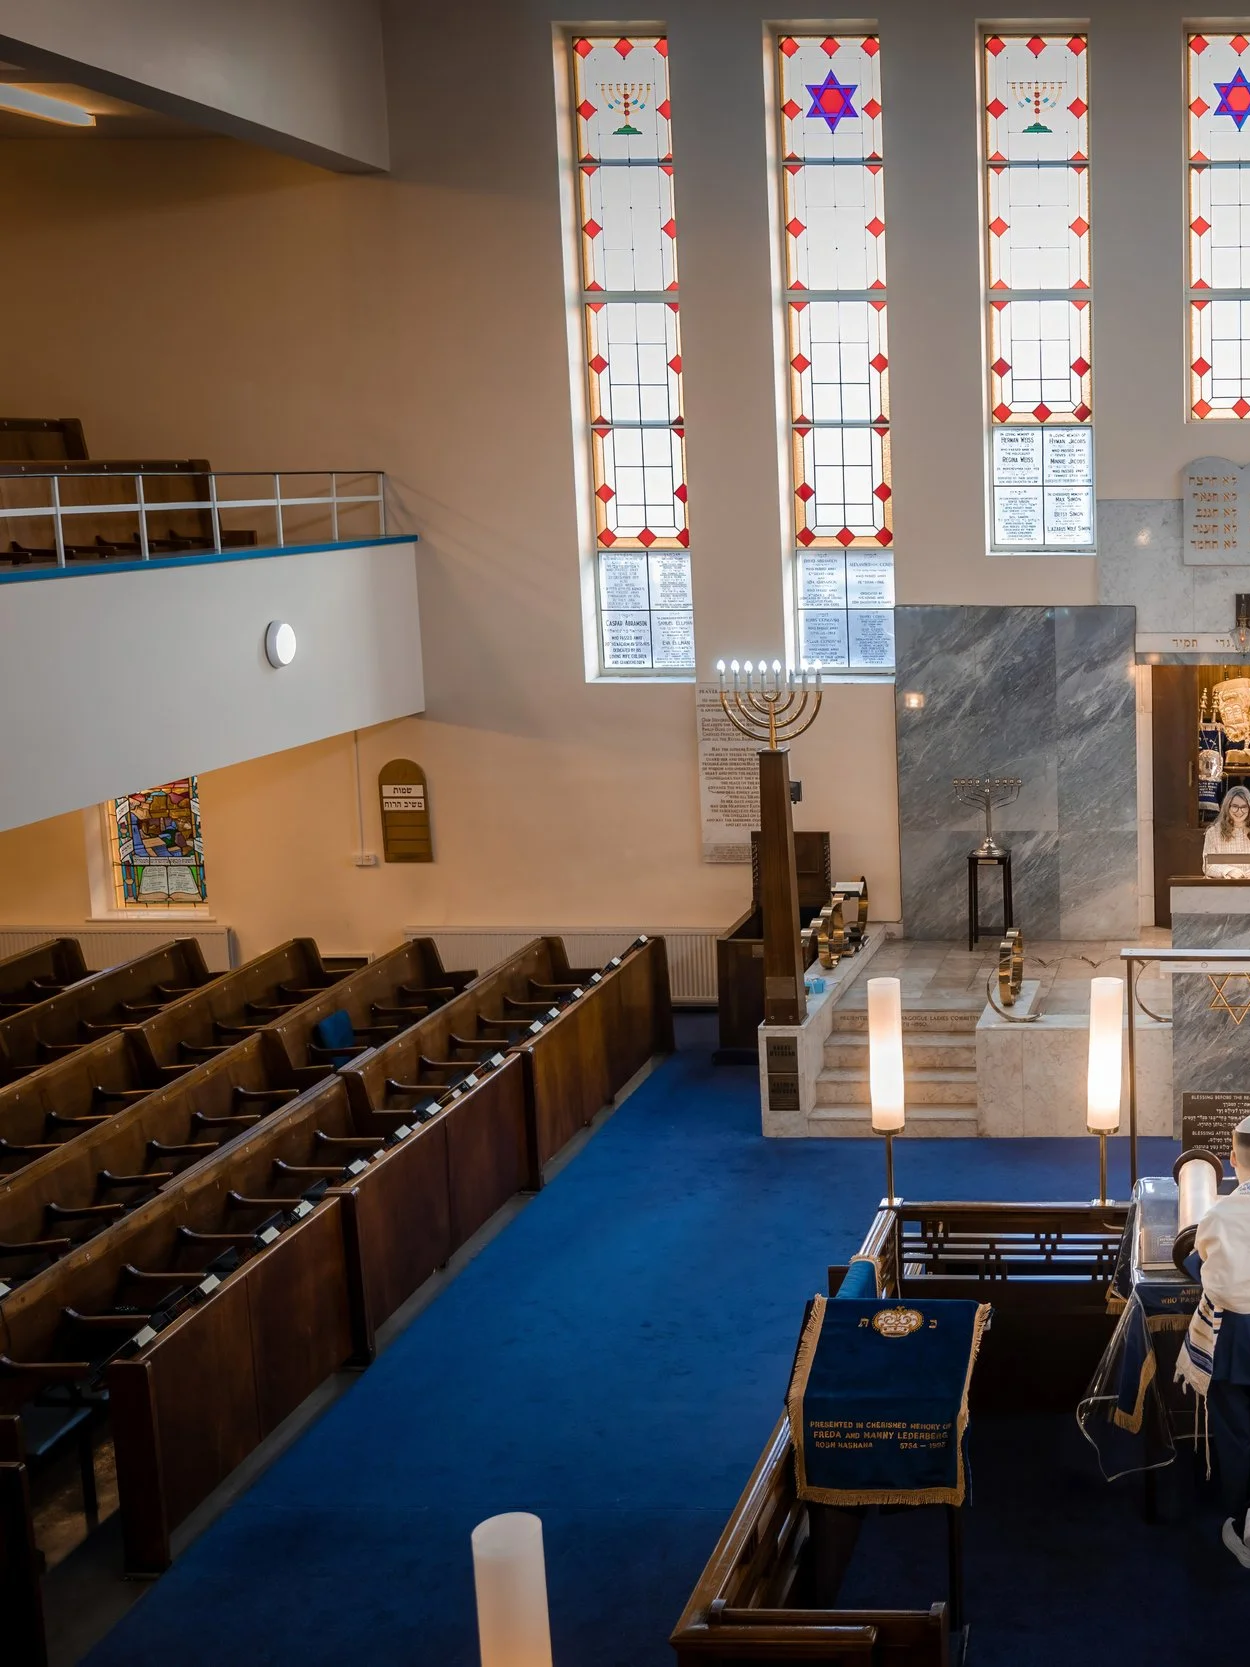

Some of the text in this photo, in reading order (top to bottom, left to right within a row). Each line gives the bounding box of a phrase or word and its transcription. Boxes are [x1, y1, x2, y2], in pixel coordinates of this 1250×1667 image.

[1172, 639, 1198, 648] תמיד
[858, 1319, 869, 1328] ת
[810, 1421, 852, 1429] PRESENTED
[814, 1431, 842, 1439] FREDA
[898, 1431, 948, 1439] LEDERBERG
